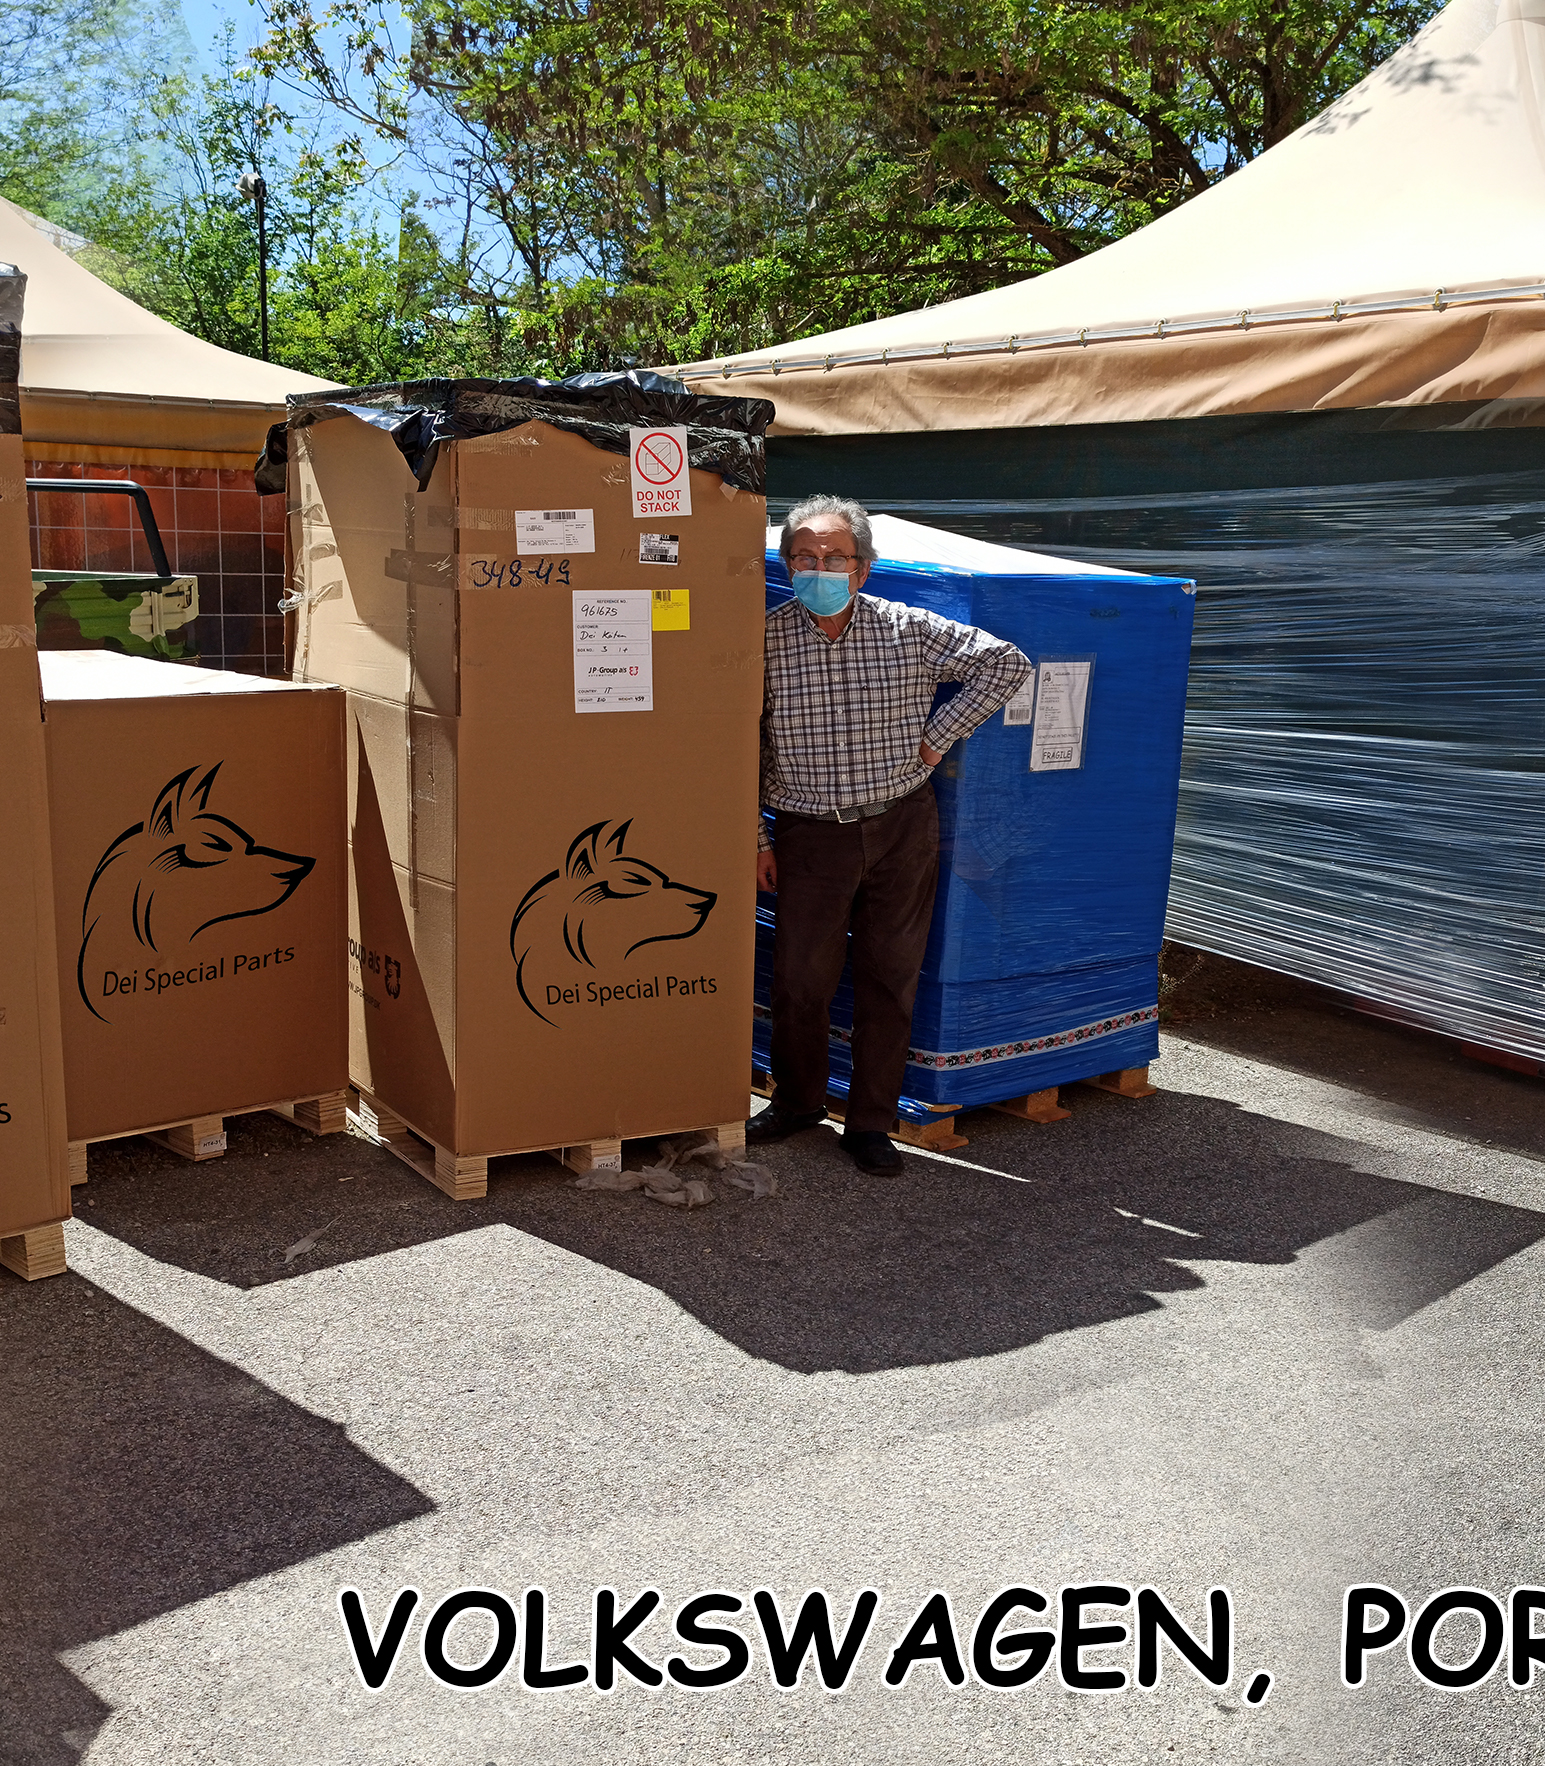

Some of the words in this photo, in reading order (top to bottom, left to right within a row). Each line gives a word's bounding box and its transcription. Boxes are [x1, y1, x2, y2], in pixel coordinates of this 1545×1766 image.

[637, 491, 654, 501] DO
[657, 490, 681, 500] NOT
[640, 502, 680, 513] STACK
[1043, 750, 1071, 760] FRAGILE
[102, 970, 138, 997] Dei
[144, 957, 225, 995] Special
[233, 946, 295, 976] Parts
[545, 983, 581, 1005] Dei
[586, 976, 660, 1007] Special
[666, 975, 718, 997] Parts
